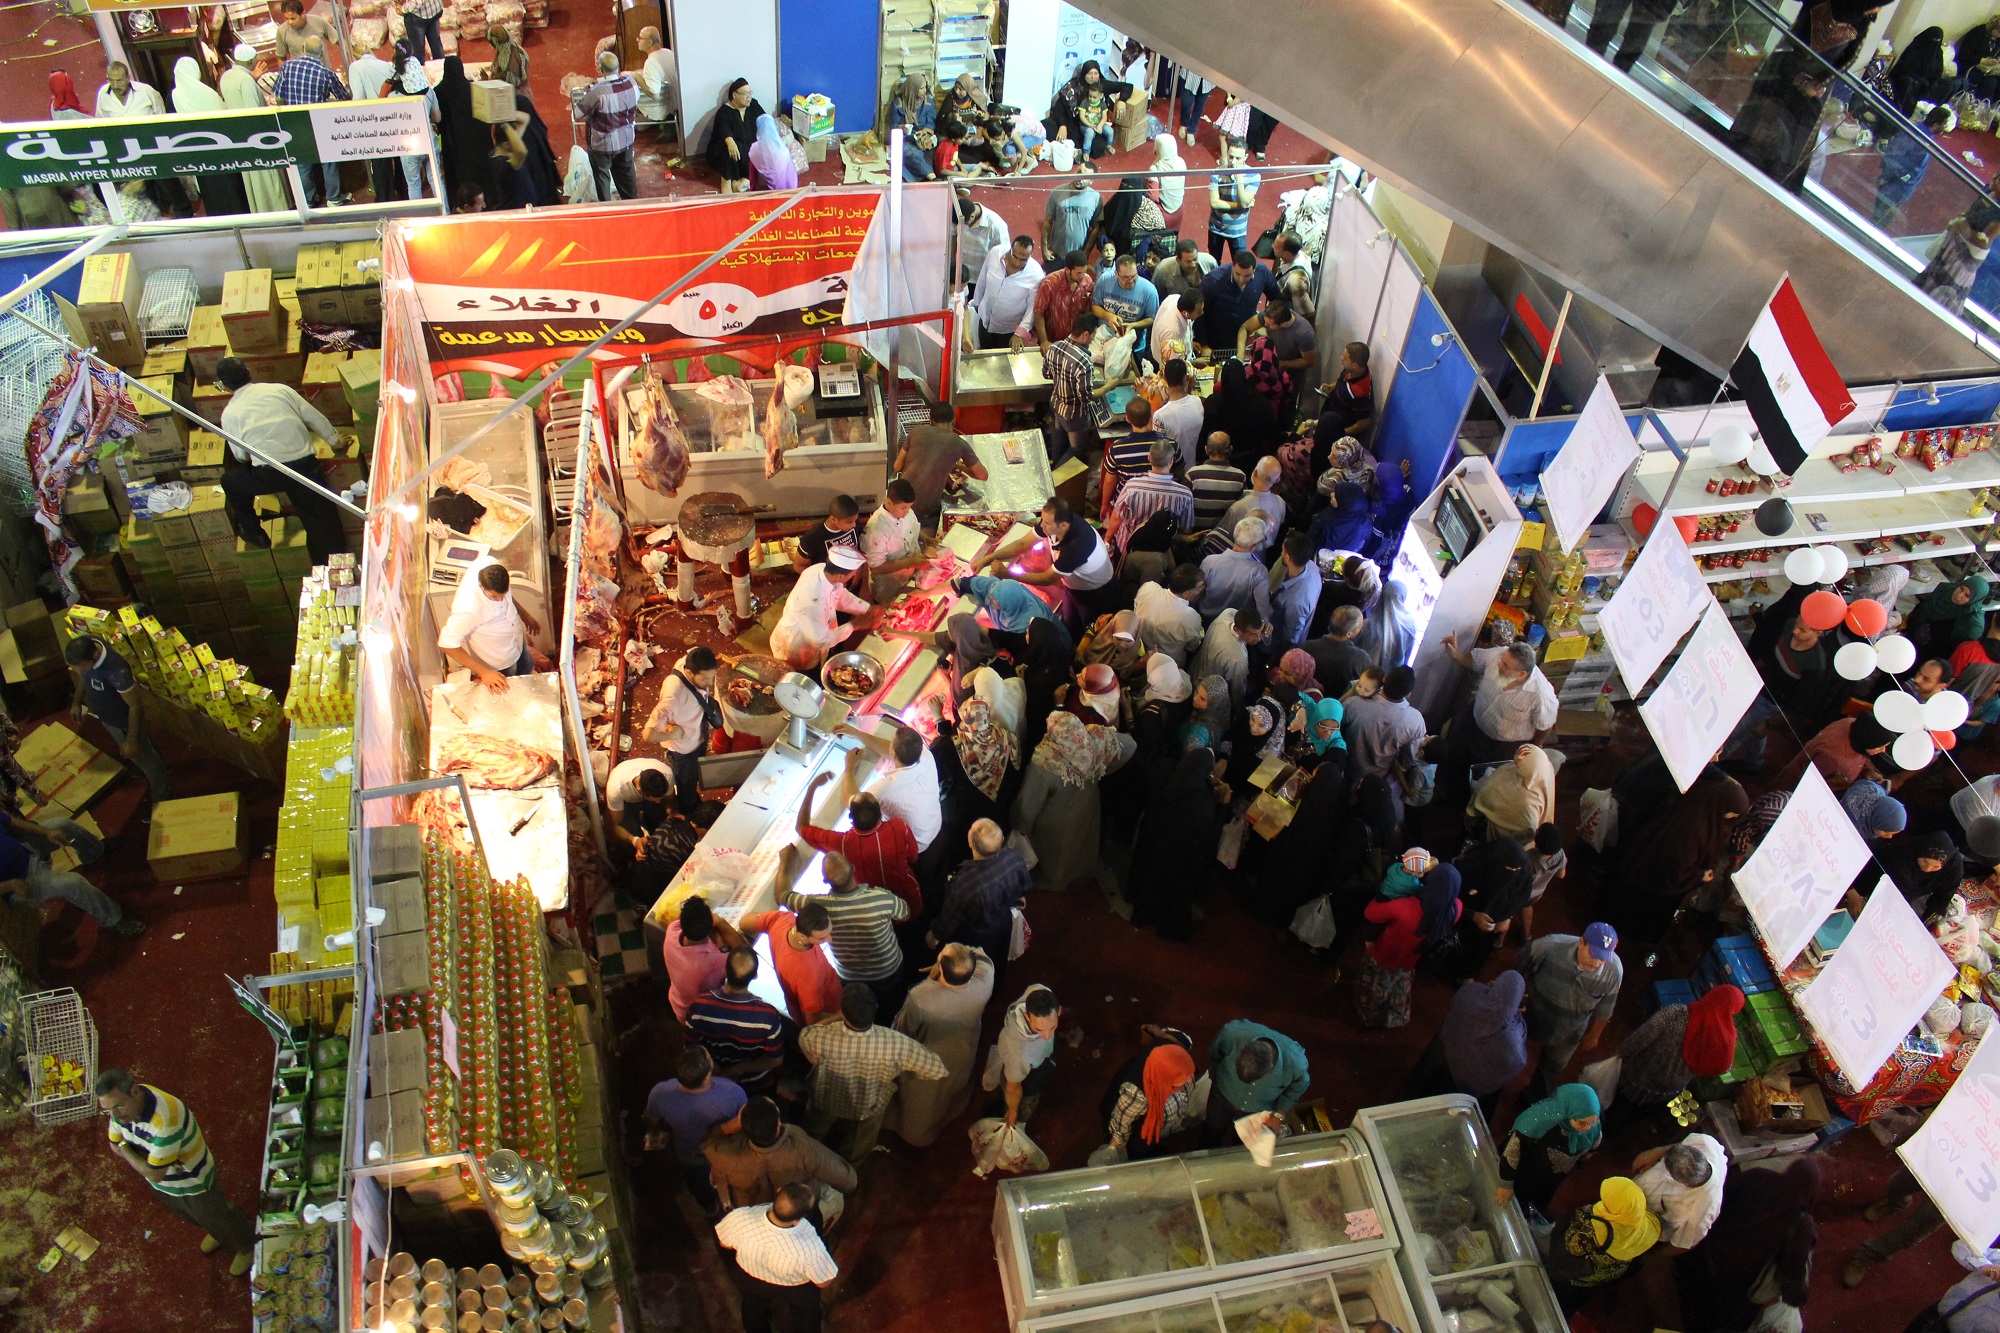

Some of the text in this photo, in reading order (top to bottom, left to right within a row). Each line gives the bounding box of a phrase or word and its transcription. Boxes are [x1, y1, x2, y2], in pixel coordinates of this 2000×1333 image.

[399, 112, 412, 120] وزارة
[6, 129, 293, 166] مصرية
[172, 156, 297, 174] مصرية هايبر ماركت
[22, 166, 158, 185] MASRIA HYPER MARKET
[798, 206, 844, 222] والتجارة
[846, 207, 875, 219] موين
[785, 227, 841, 240] للصناعات
[457, 294, 601, 315] الغلاء
[699, 299, 738, 320] ٥٠
[432, 326, 536, 346] مدعمة
